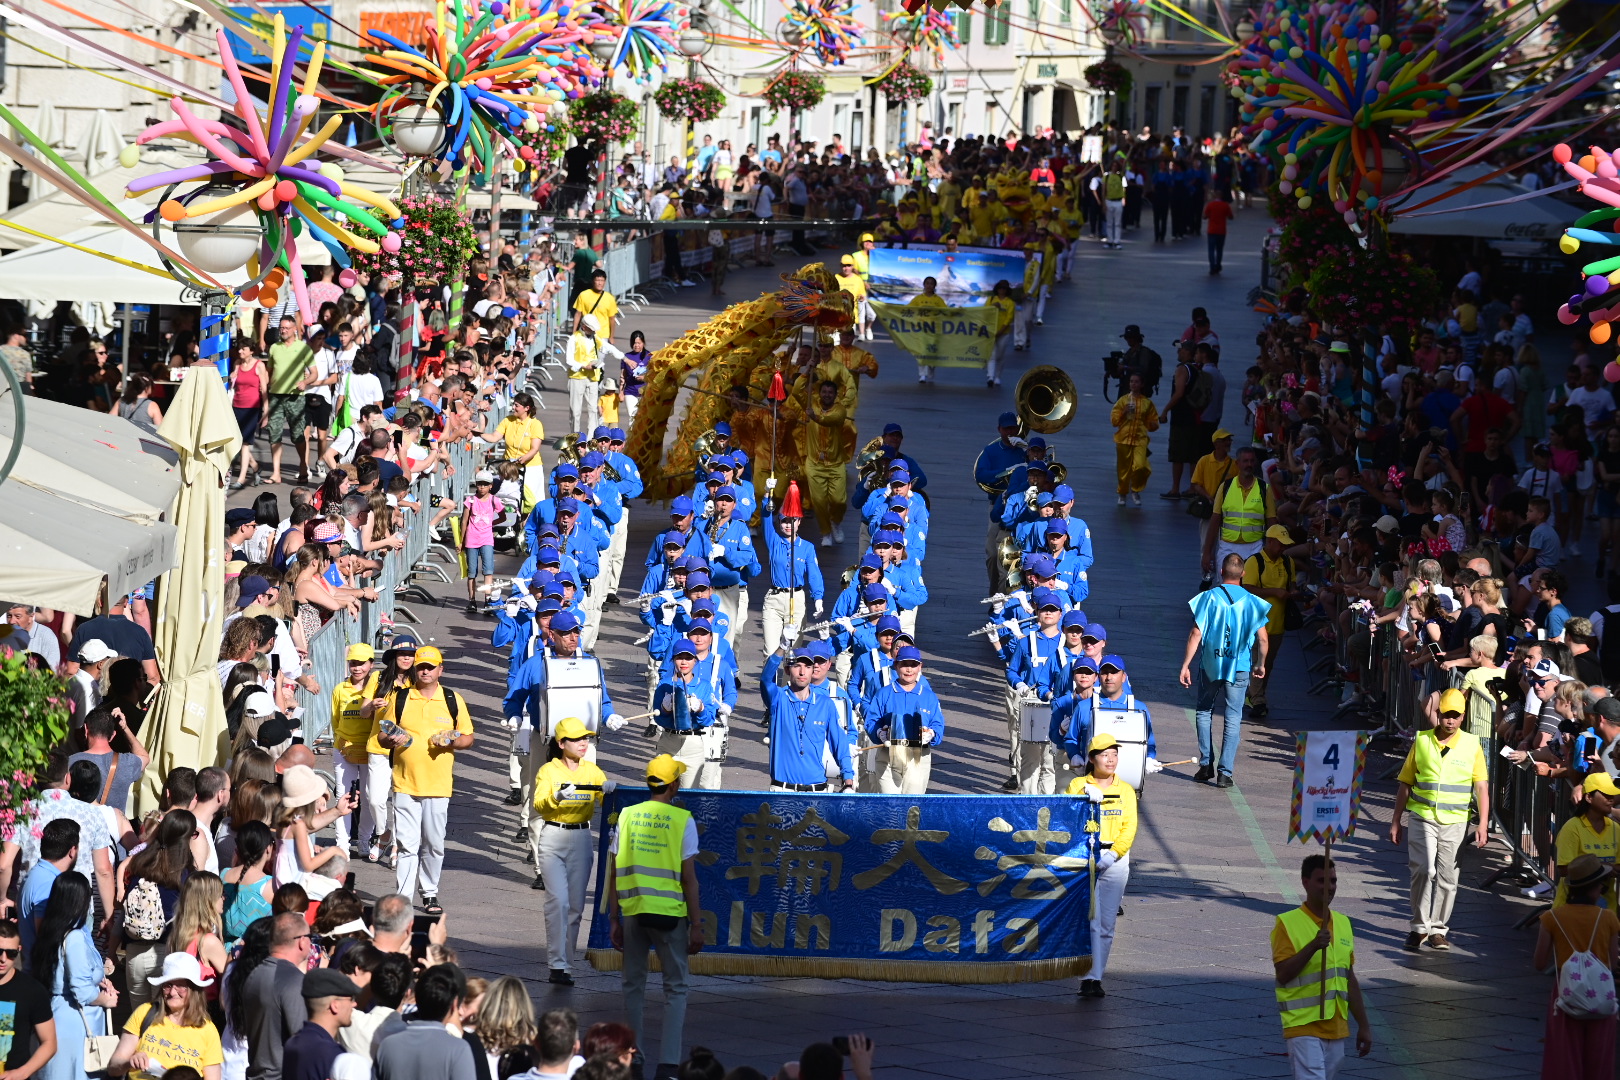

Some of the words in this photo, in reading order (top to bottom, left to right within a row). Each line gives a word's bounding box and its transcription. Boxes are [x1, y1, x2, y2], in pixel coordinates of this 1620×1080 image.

[882, 317, 936, 334] ALUN
[942, 321, 990, 338] DAFA
[1323, 743, 1339, 770] 4
[1316, 807, 1335, 815] ERSTE
[631, 820, 652, 828] FALUN
[654, 822, 670, 830] DAFA
[672, 800, 1089, 900] 輪大法
[688, 900, 831, 950] alun
[879, 908, 1040, 954] Dafa
